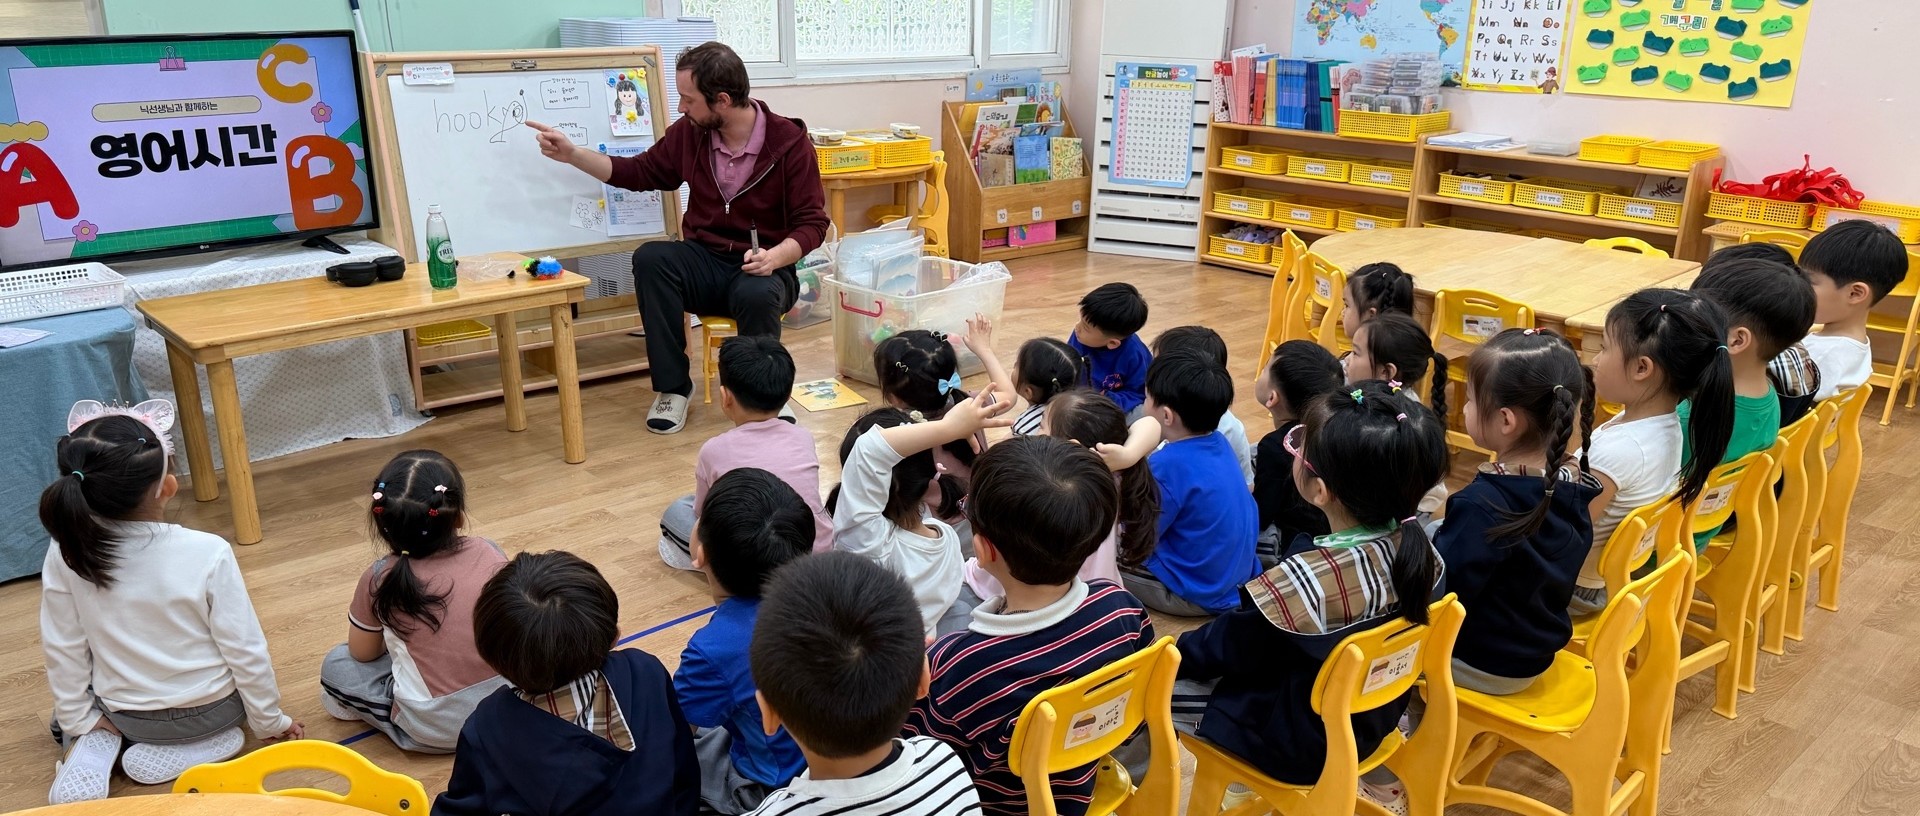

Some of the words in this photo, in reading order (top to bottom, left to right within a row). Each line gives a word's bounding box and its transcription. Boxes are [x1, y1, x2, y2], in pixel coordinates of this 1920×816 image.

[1660, 14, 1708, 31] 개구리
[257, 44, 314, 104] C
[139, 103, 183, 115] 닉선생님과
[184, 102, 218, 112] 함께하는
[90, 124, 277, 179] 영어시간
[0, 142, 80, 228] A
[285, 135, 363, 232] B
